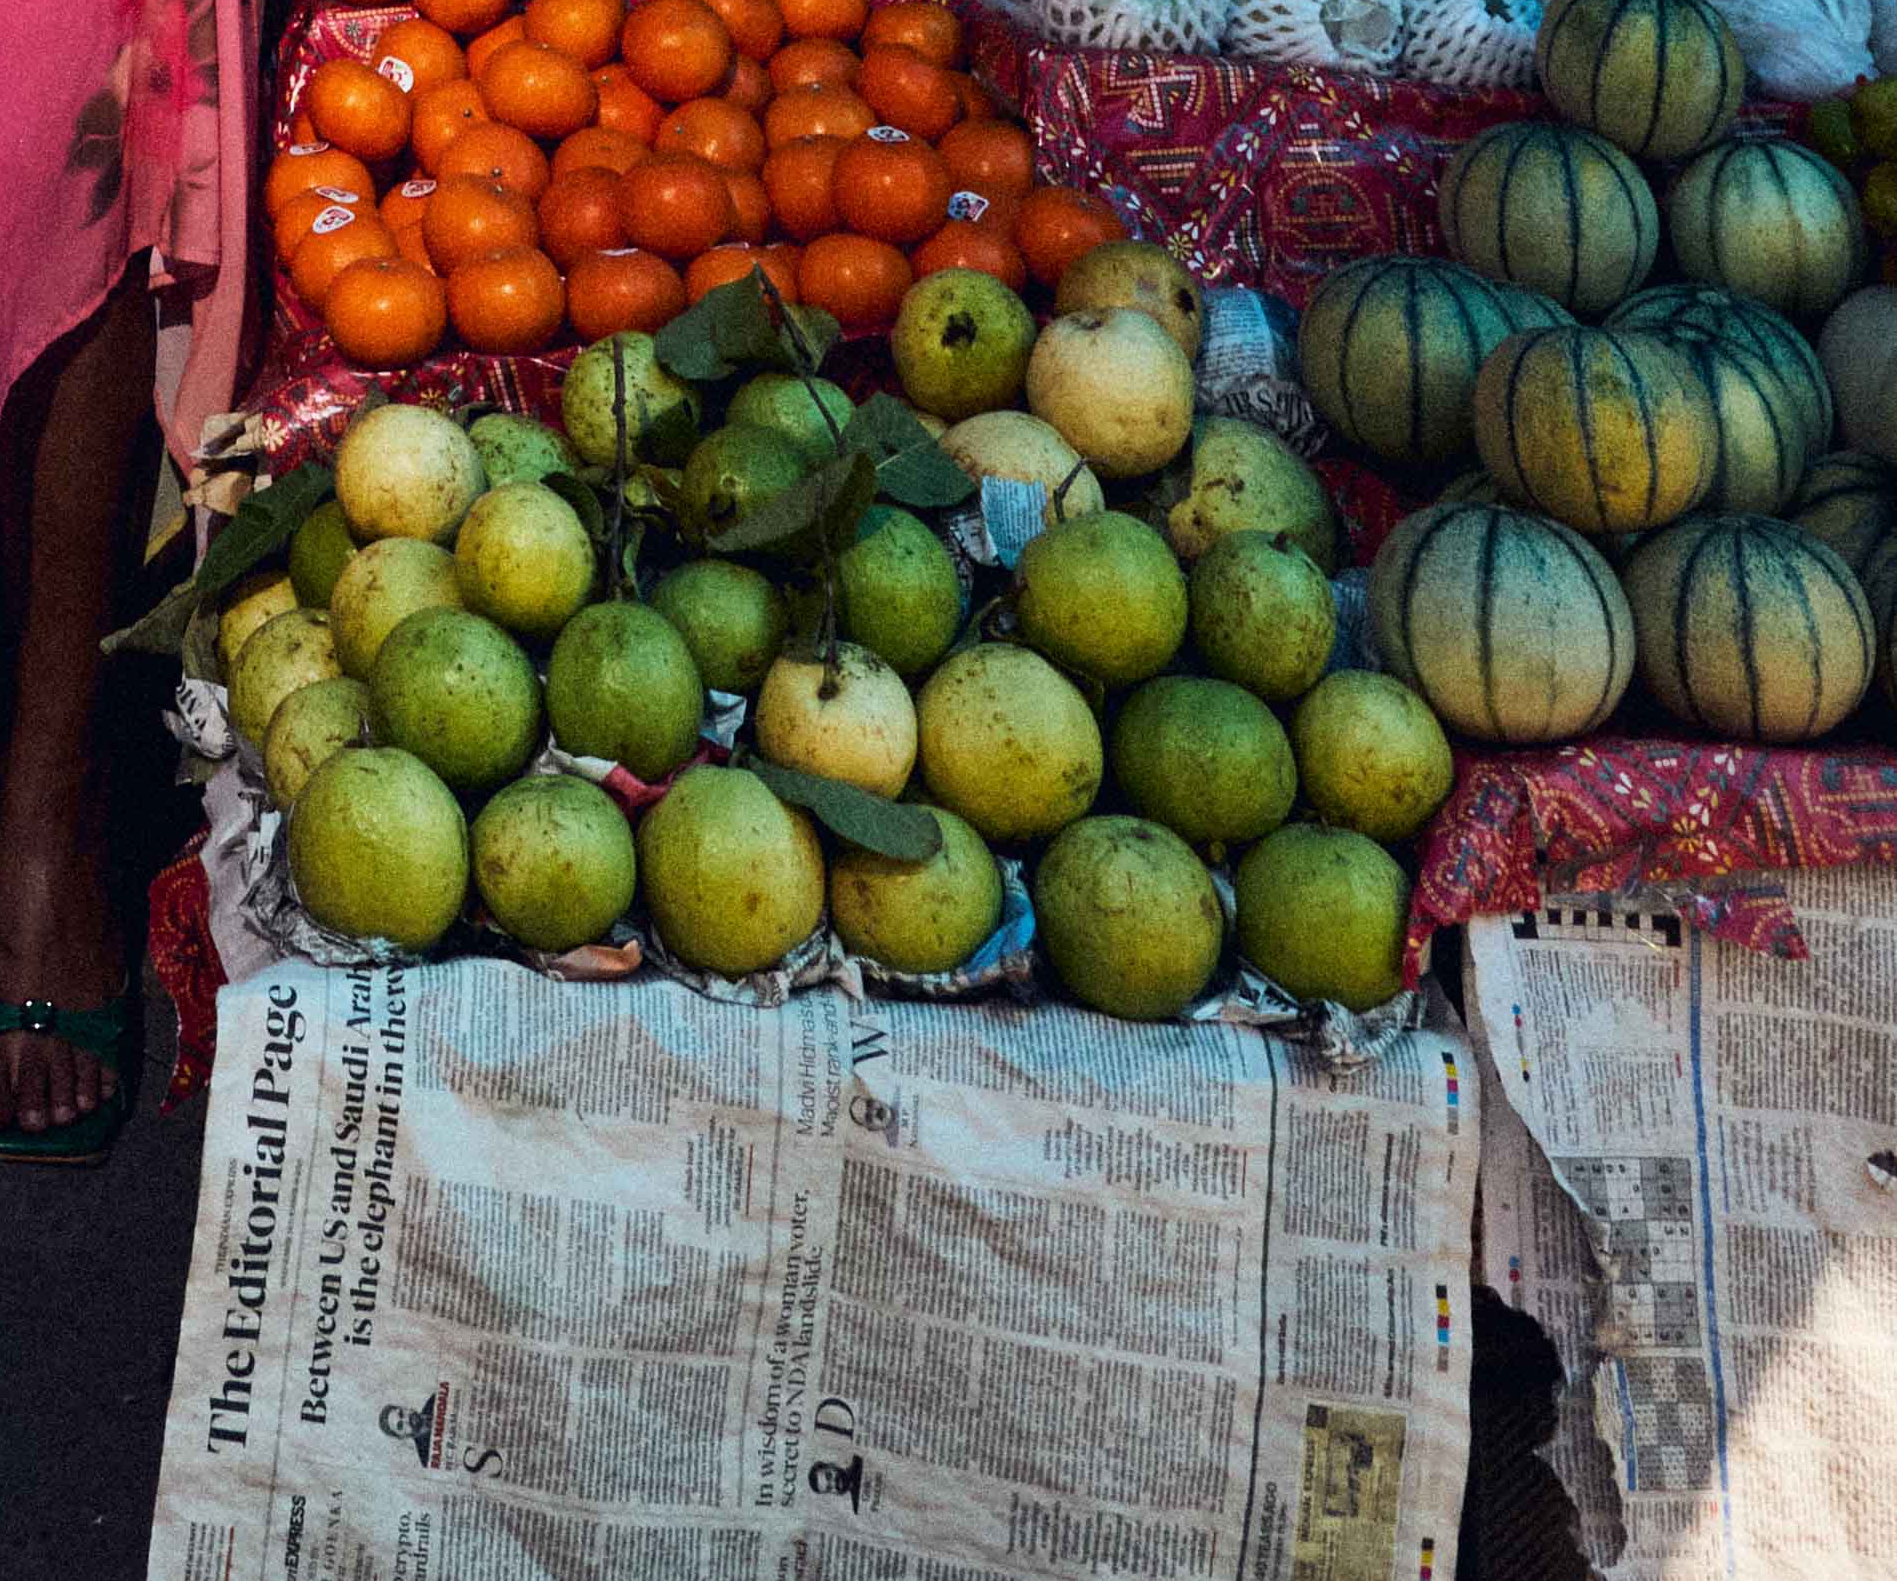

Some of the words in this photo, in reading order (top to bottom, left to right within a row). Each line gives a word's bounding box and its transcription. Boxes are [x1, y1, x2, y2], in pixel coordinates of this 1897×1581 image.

[252, 984, 307, 1105] Page
[379, 999, 407, 1054] the
[851, 1019, 889, 1065] W
[335, 1044, 370, 1144] Saudi
[375, 1061, 403, 1097] in
[796, 1079, 816, 1136] Madvi
[821, 1079, 842, 1137] Maoist
[330, 1146, 357, 1215] and
[358, 1101, 400, 1252] elephant
[222, 1114, 289, 1342] Editorial
[319, 1218, 349, 1265] US
[790, 1189, 811, 1252] voter,
[349, 1255, 381, 1313] the
[775, 1255, 802, 1337] woman
[792, 1244, 823, 1347] landslide
[300, 1273, 342, 1424] Between
[343, 1317, 374, 1347] is
[774, 1340, 788, 1354] a
[765, 1353, 786, 1380] of
[787, 1351, 810, 1407] NDA
[207, 1349, 255, 1454] The
[433, 1381, 450, 1438] MANDALA
[757, 1383, 782, 1477] wisdom
[786, 1411, 803, 1435] to
[814, 1397, 855, 1440] D
[430, 1439, 444, 1470] RAJA
[463, 1446, 504, 1479] S
[781, 1438, 800, 1508] secret
[755, 1484, 773, 1507] In
[1263, 1482, 1278, 1515] AGO
[323, 1490, 343, 1571] GOENKA
[392, 1511, 413, 1577] crypto,
